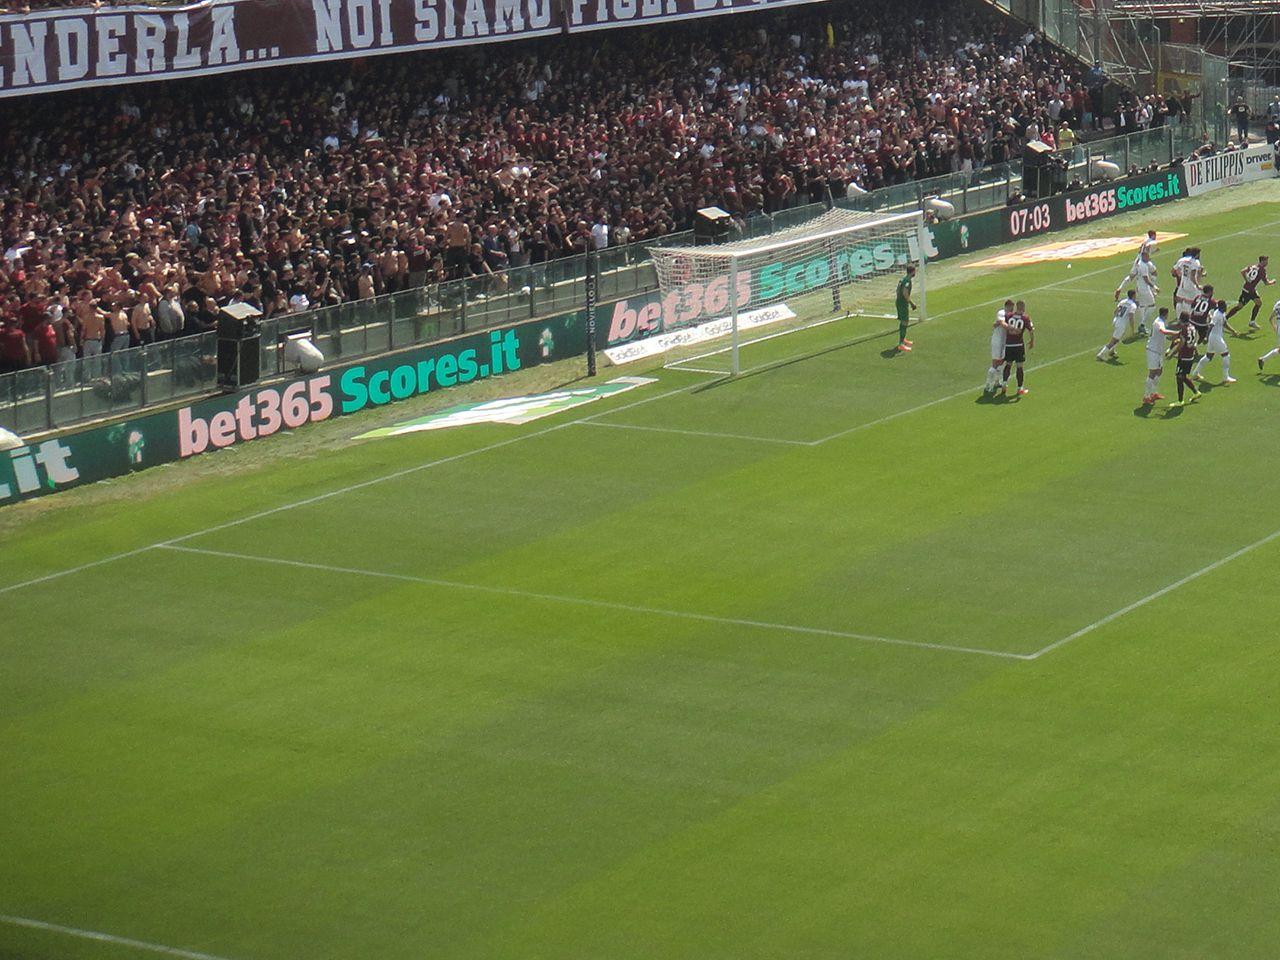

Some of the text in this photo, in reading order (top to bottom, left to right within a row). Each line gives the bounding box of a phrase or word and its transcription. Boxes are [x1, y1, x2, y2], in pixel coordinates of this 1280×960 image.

[0, 6, 280, 88] NDERLA...
[1065, 172, 1180, 225] bet365 Scores.it
[1190, 151, 1244, 187] DE FILIPPIS
[1010, 203, 1051, 236] 07:03
[607, 228, 939, 344] bet365 Scores.it
[178, 375, 334, 458] bet365
[340, 329, 521, 414] Scores.it
